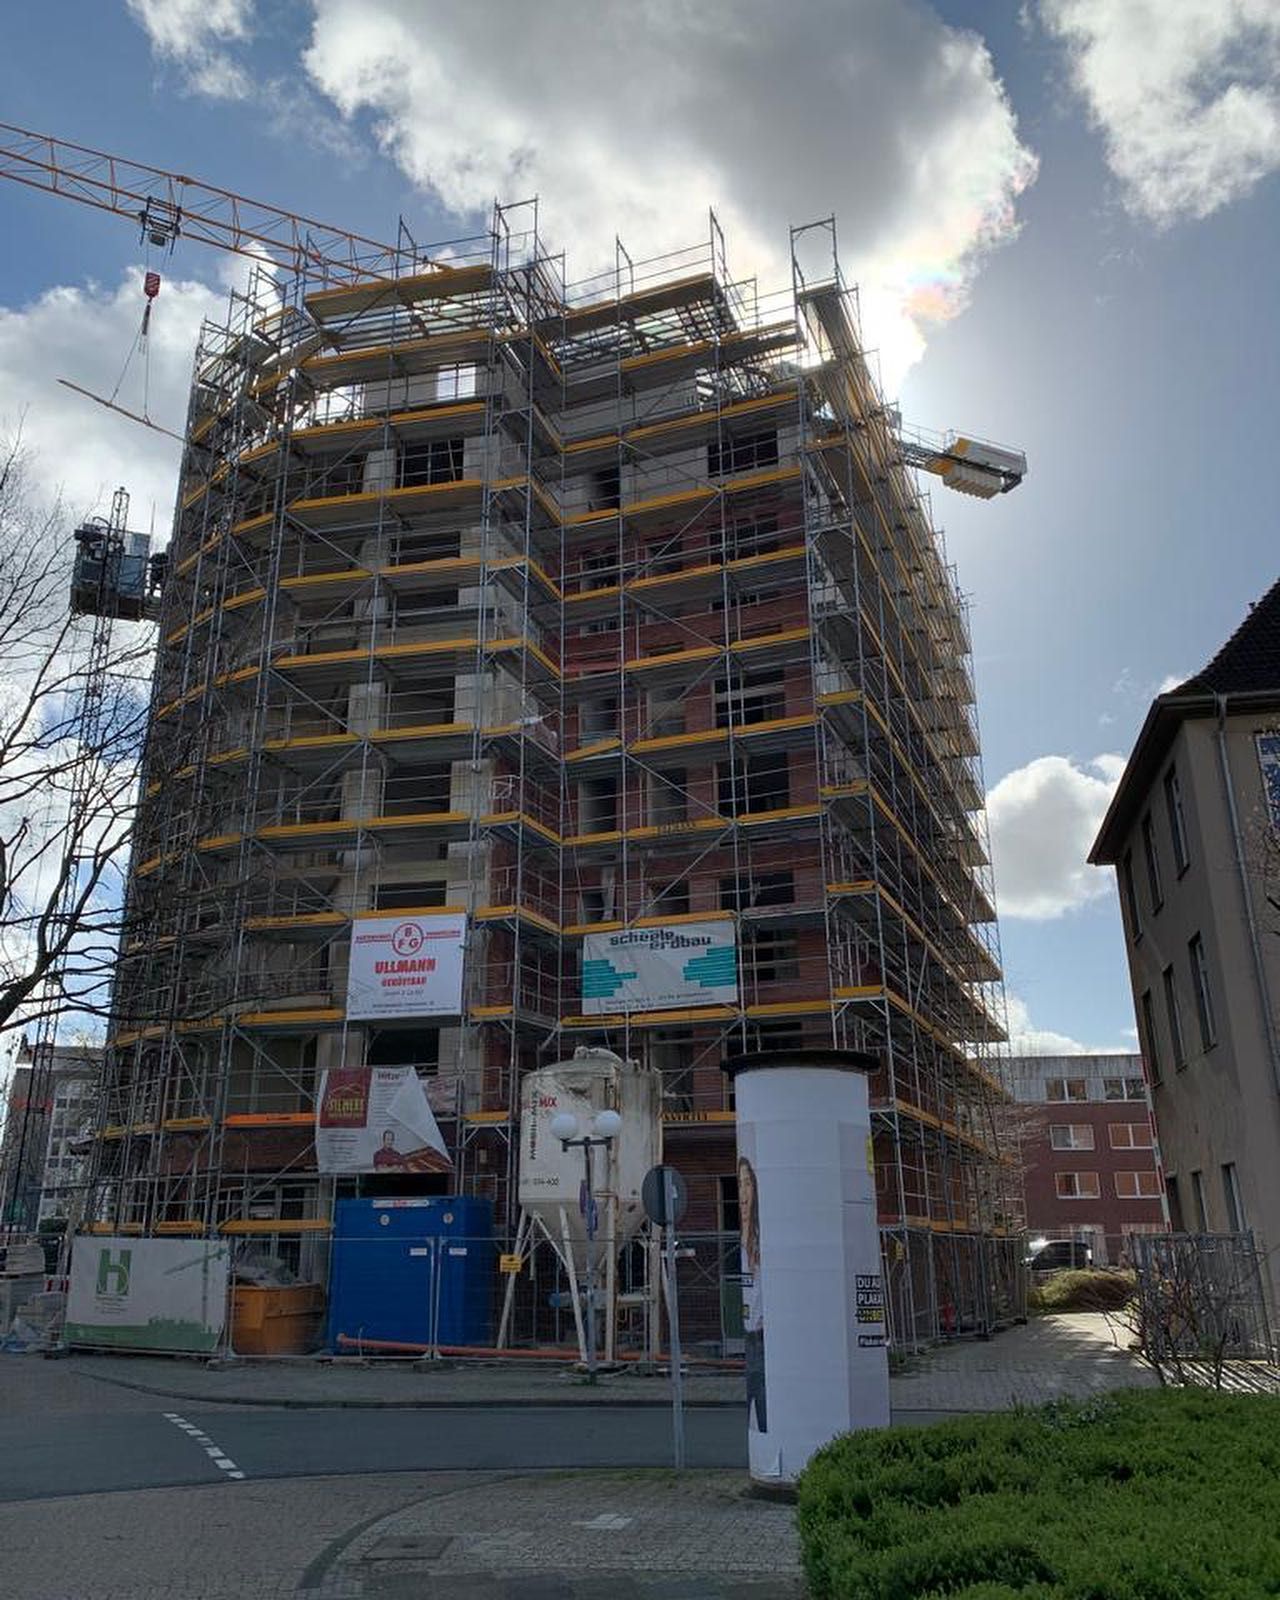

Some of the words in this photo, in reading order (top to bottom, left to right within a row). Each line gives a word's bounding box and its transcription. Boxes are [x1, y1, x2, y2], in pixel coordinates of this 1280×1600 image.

[409, 937, 419, 949] G
[650, 934, 712, 951] erdbau
[375, 958, 437, 974] ULLMANN
